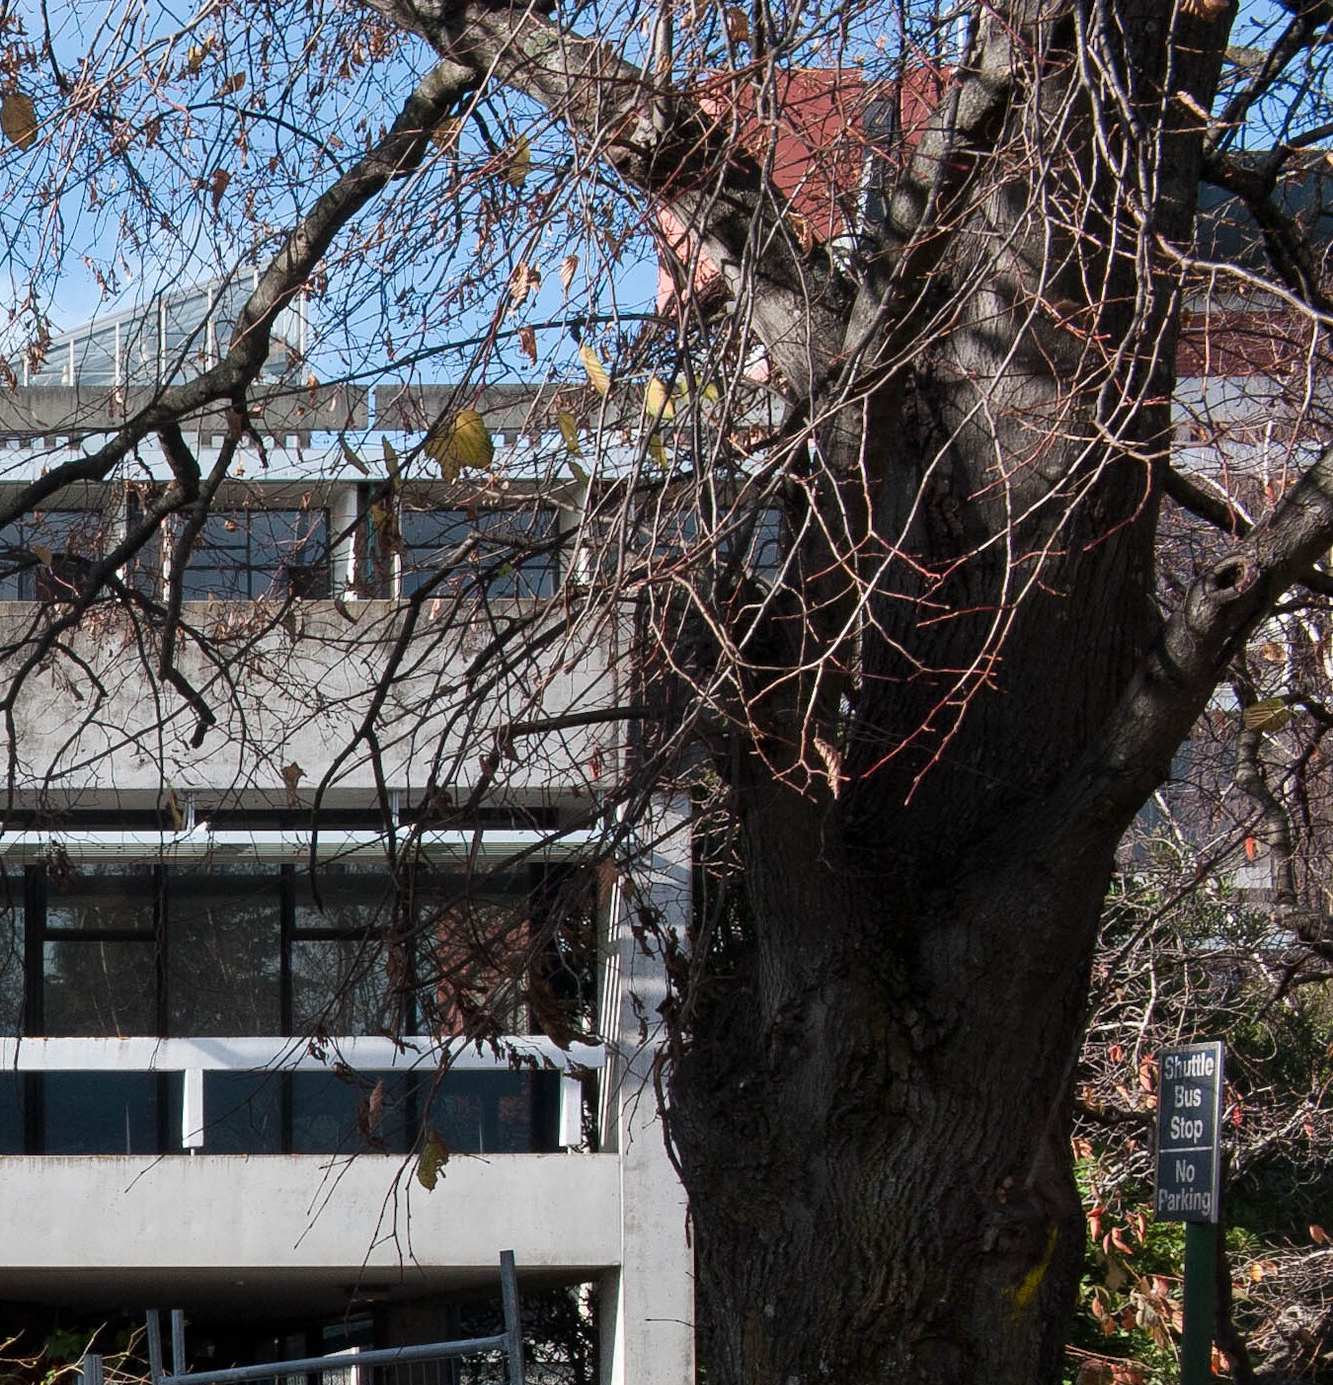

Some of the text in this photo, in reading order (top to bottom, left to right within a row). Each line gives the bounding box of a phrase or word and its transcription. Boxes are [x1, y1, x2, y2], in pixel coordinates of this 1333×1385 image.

[1164, 1052, 1214, 1079] Shuttle
[1174, 1085, 1202, 1108] Bus
[1170, 1116, 1204, 1144] Stop
[1175, 1159, 1195, 1183] No
[1158, 1188, 1212, 1216] Parking
